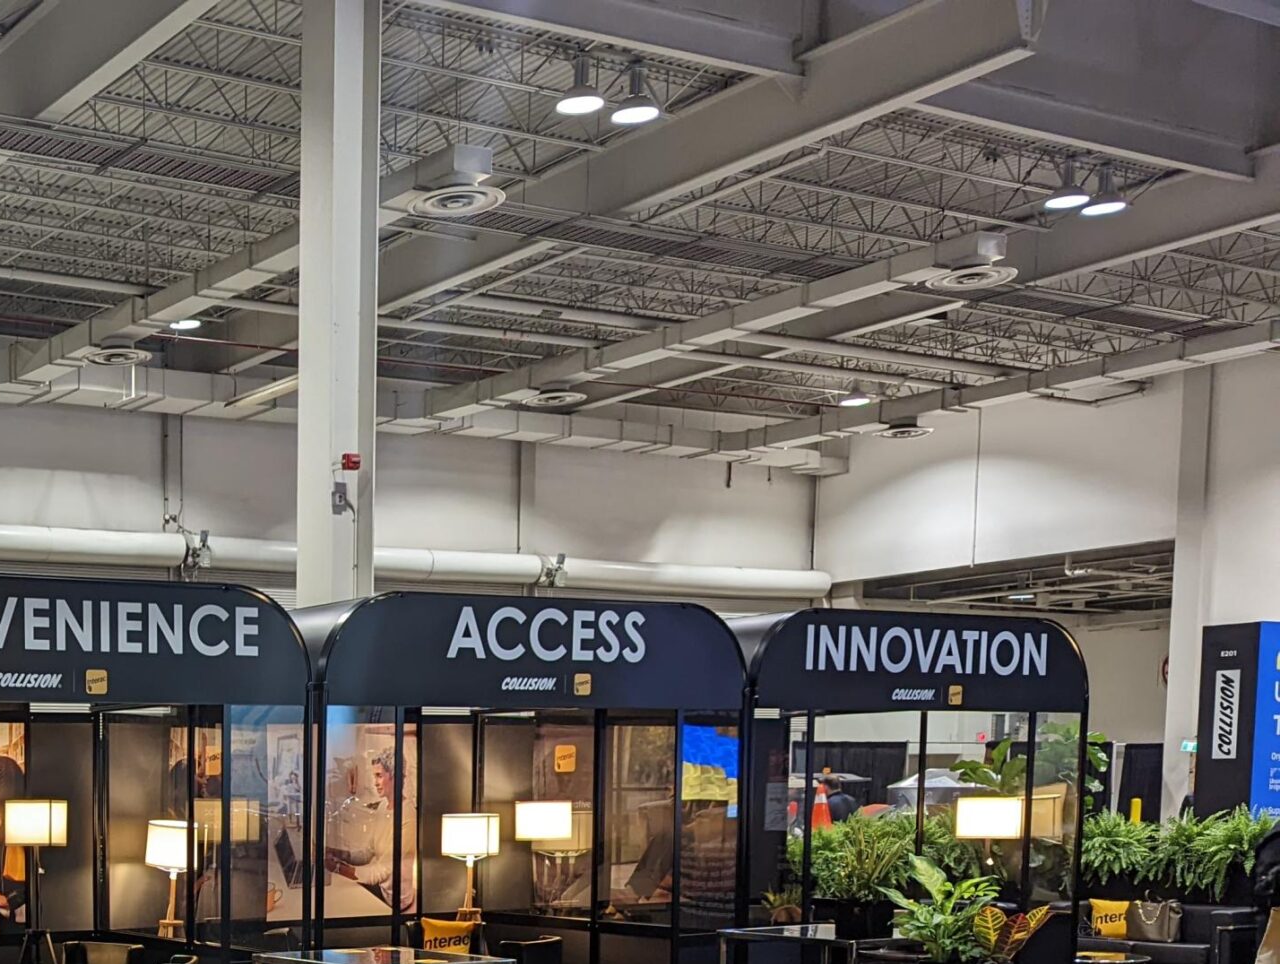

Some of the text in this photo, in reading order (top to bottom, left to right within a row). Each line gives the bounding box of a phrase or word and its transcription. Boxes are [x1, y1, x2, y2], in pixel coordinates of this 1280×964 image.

[446, 606, 646, 663] ACCESS
[805, 624, 1048, 676] INNOVATION
[501, 677, 557, 691] COLLISION
[1217, 673, 1235, 756] COLLISION
[424, 935, 470, 950] nterac
